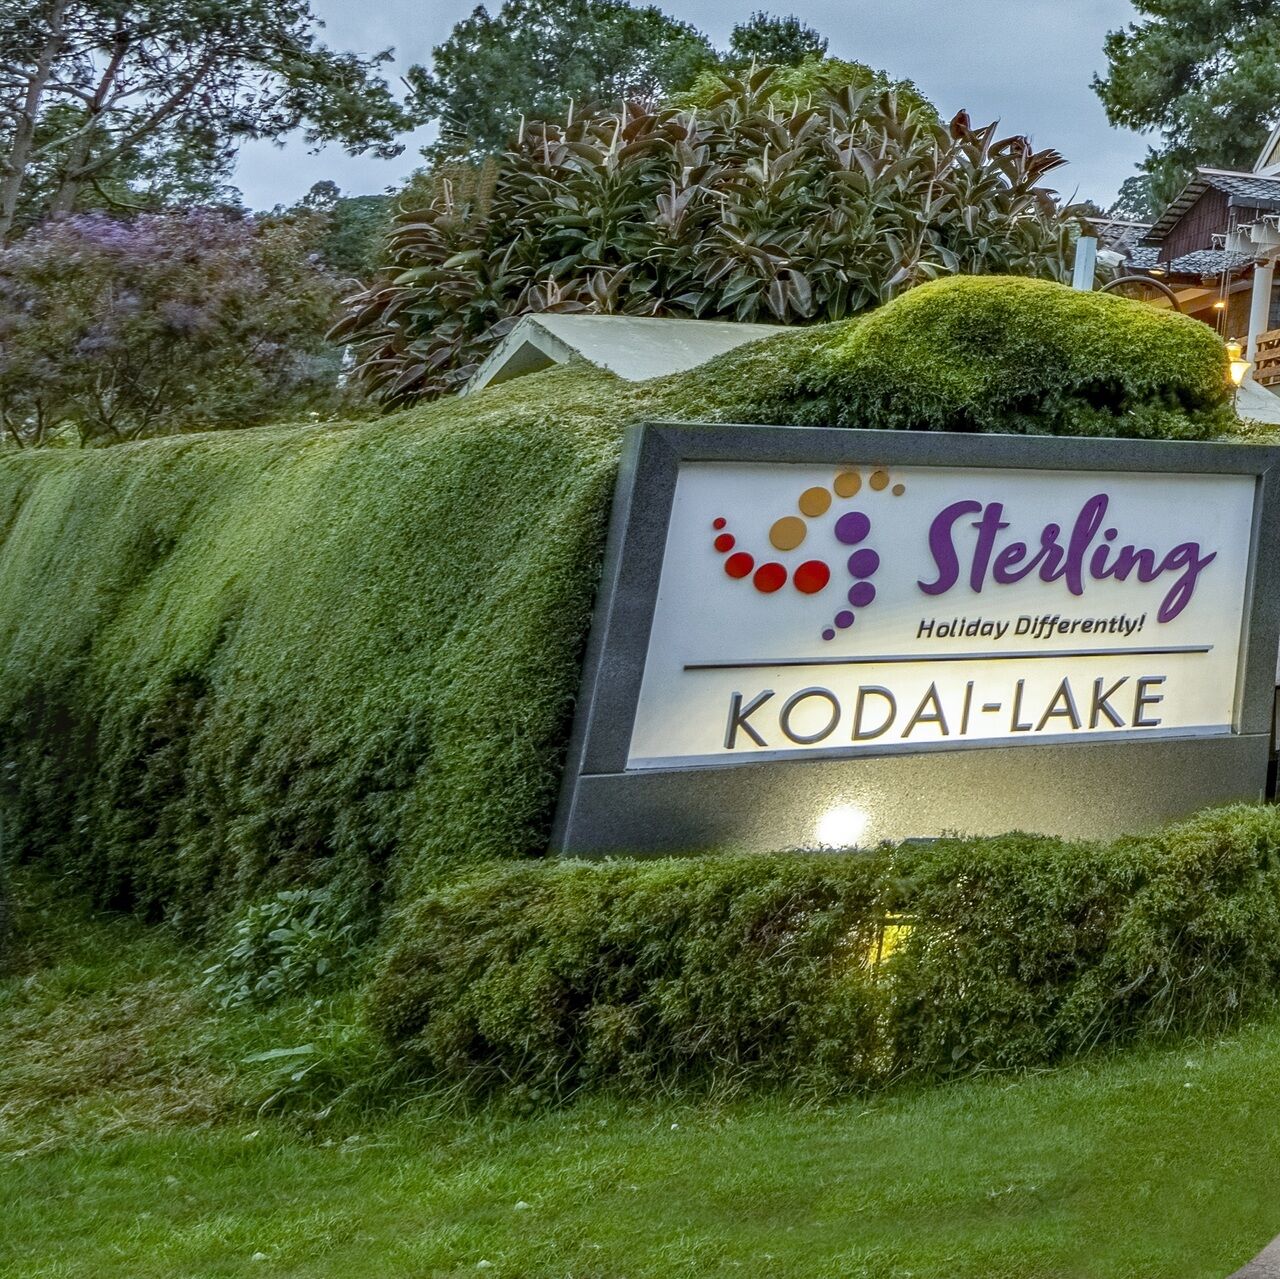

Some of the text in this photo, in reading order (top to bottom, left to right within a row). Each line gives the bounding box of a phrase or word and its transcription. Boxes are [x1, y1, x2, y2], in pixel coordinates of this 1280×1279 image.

[917, 493, 1217, 623] Sterling
[916, 612, 1147, 640] Holiday Differently!
[723, 675, 1167, 749] KODAI-LAKE
